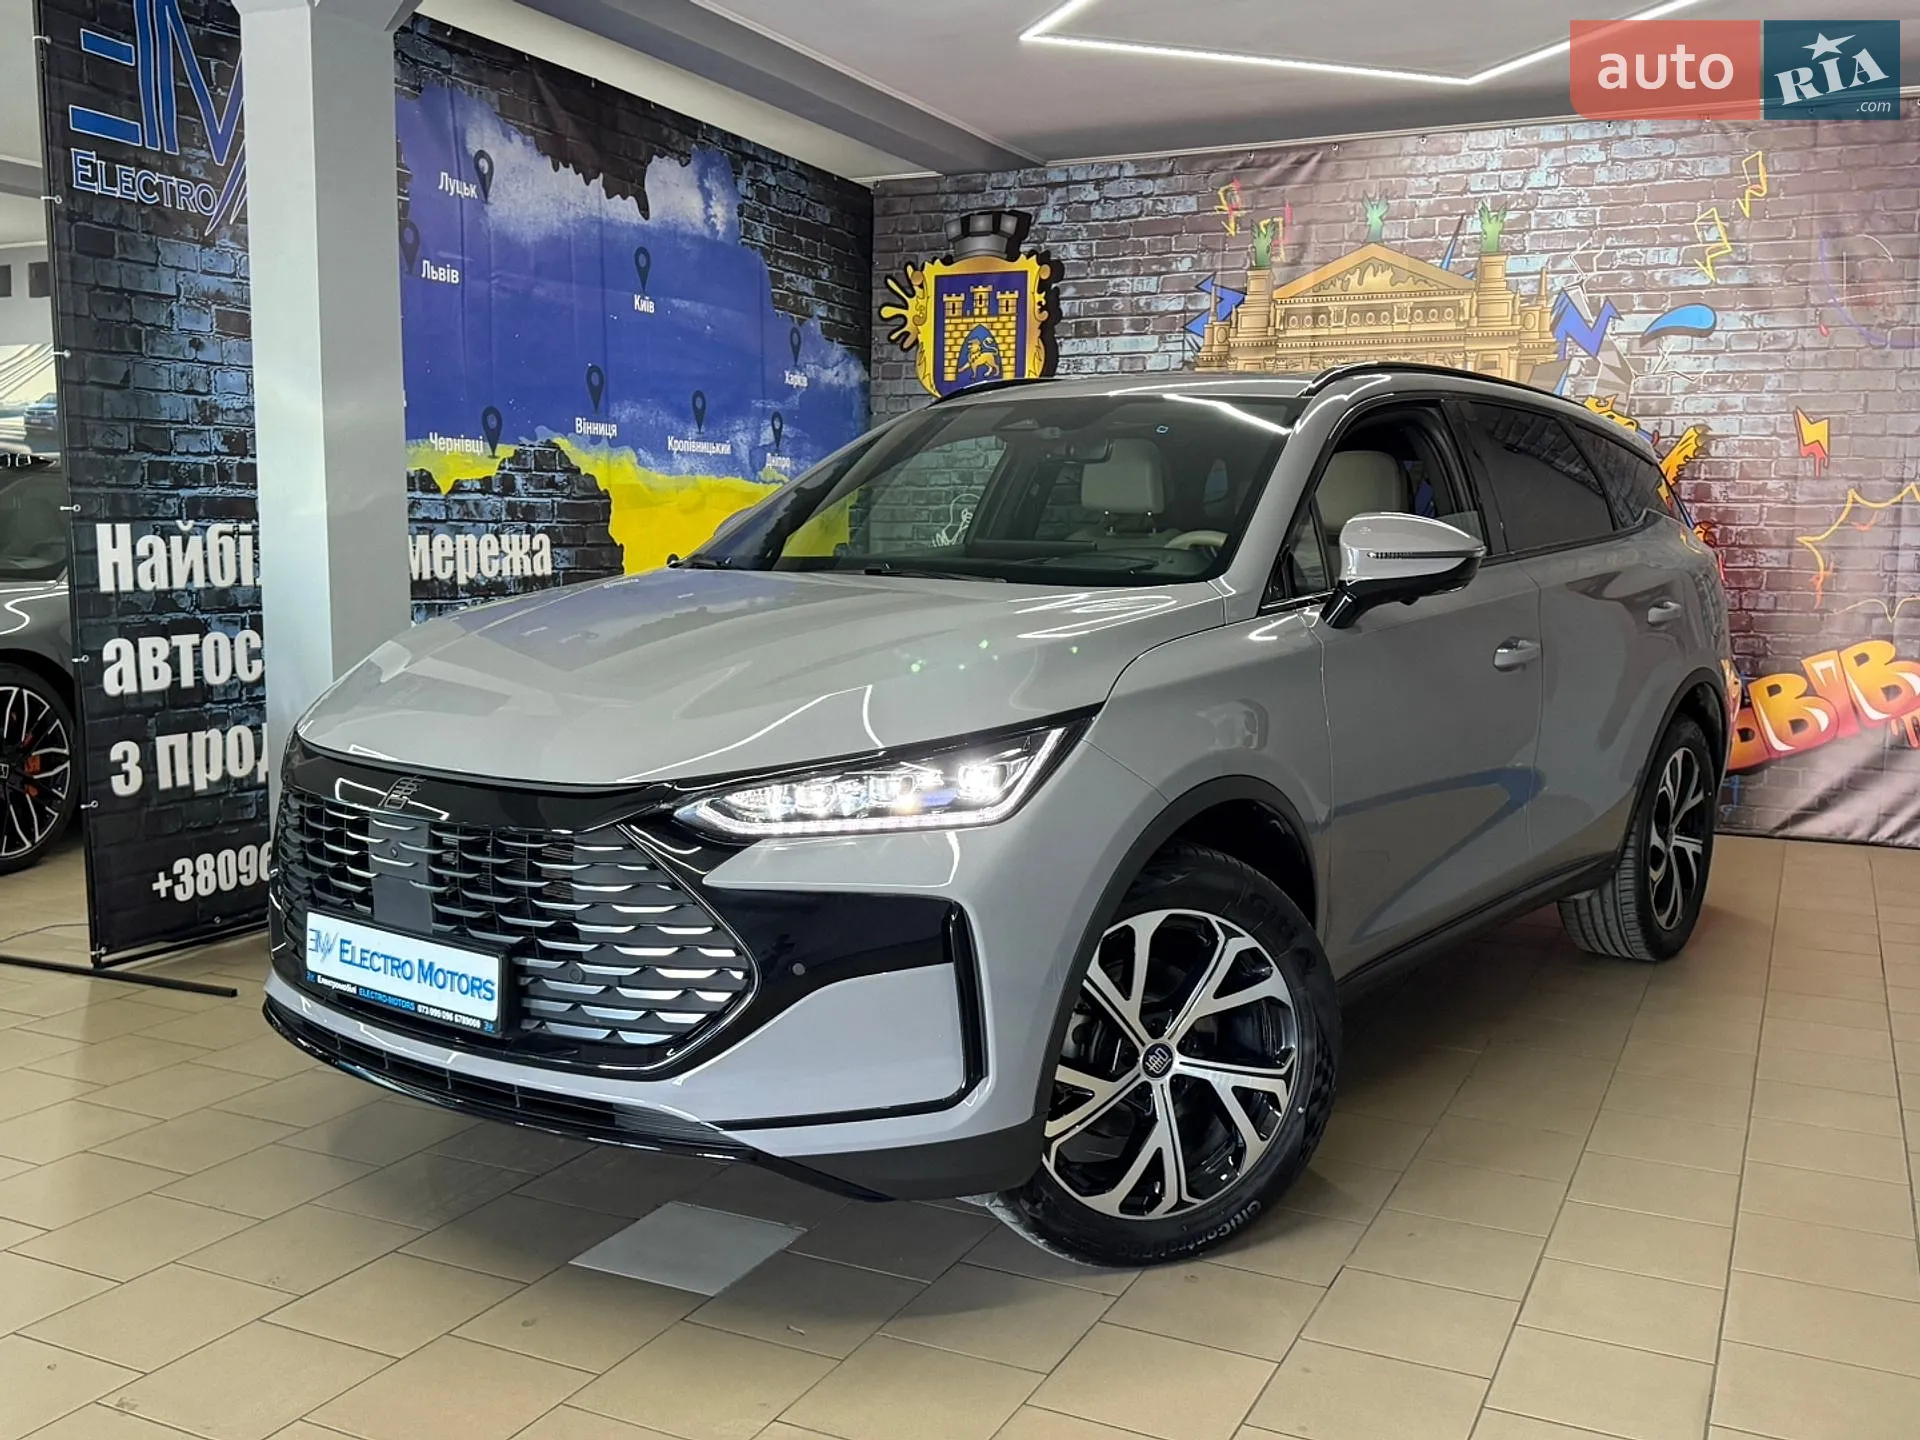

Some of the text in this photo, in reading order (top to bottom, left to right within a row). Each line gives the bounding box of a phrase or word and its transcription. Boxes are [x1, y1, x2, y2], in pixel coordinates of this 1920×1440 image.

[71, 148, 218, 216] ELECTRO
[438, 171, 478, 199] Луцьк
[421, 259, 460, 284] Львів
[634, 294, 655, 314] Київ
[575, 417, 618, 437] Вінниця
[429, 431, 484, 456] Чернівці
[667, 435, 732, 456] Кропівницький
[96, 521, 553, 592] Найбі мережа
[102, 629, 263, 697] автос
[340, 938, 414, 981] ELECTRO
[417, 958, 496, 1001] MOTORS
